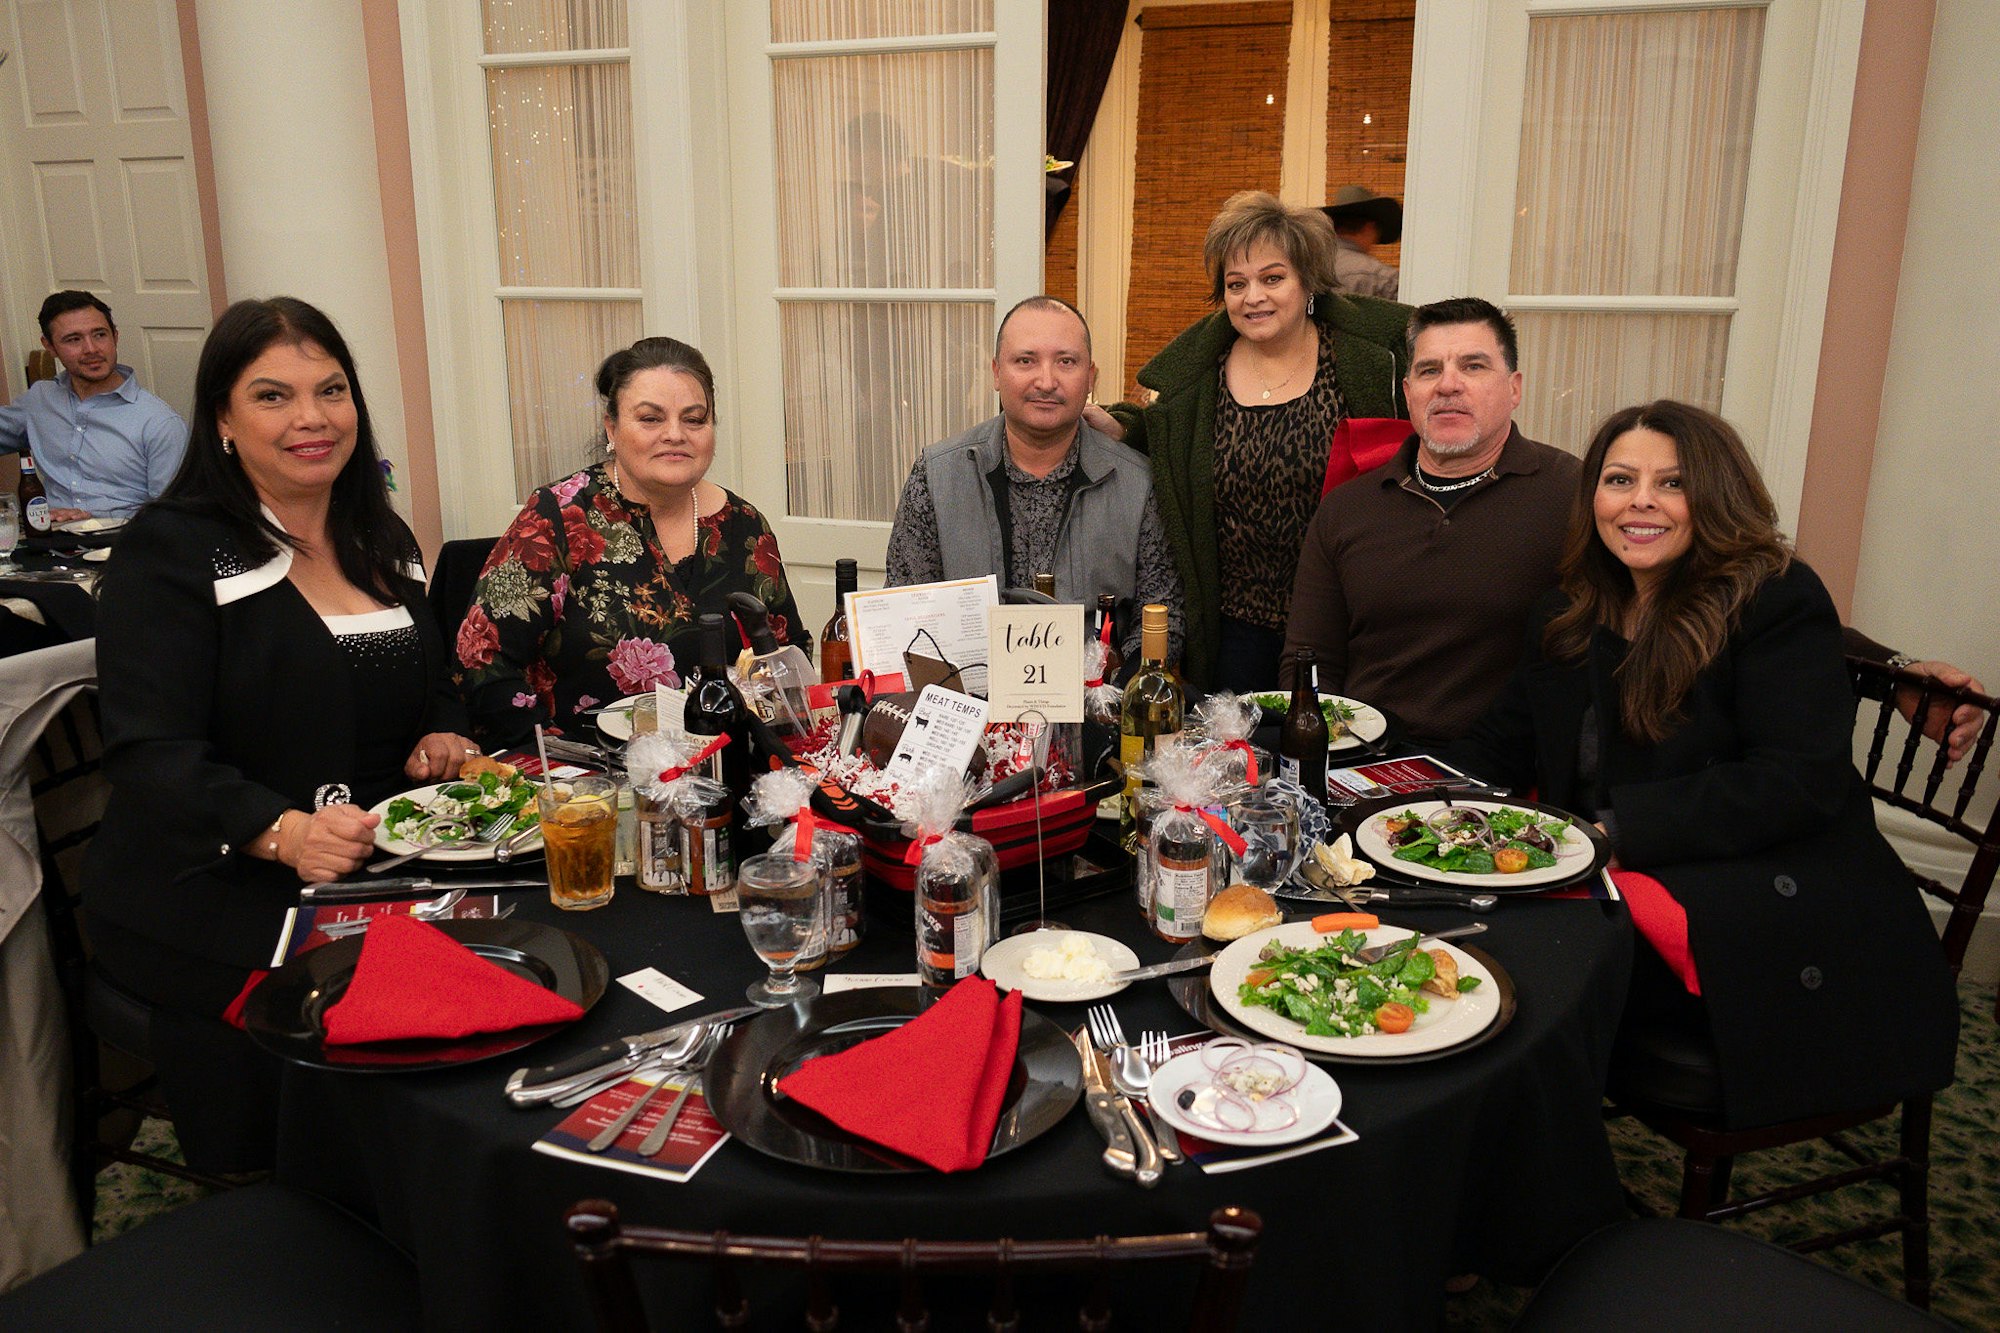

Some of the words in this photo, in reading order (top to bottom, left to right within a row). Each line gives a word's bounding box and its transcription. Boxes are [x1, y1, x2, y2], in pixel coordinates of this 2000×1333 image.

[997, 621, 1065, 654] table
[1023, 664, 1047, 684] 21
[925, 692, 950, 707] MEAT
[951, 700, 982, 718] TEMPS
